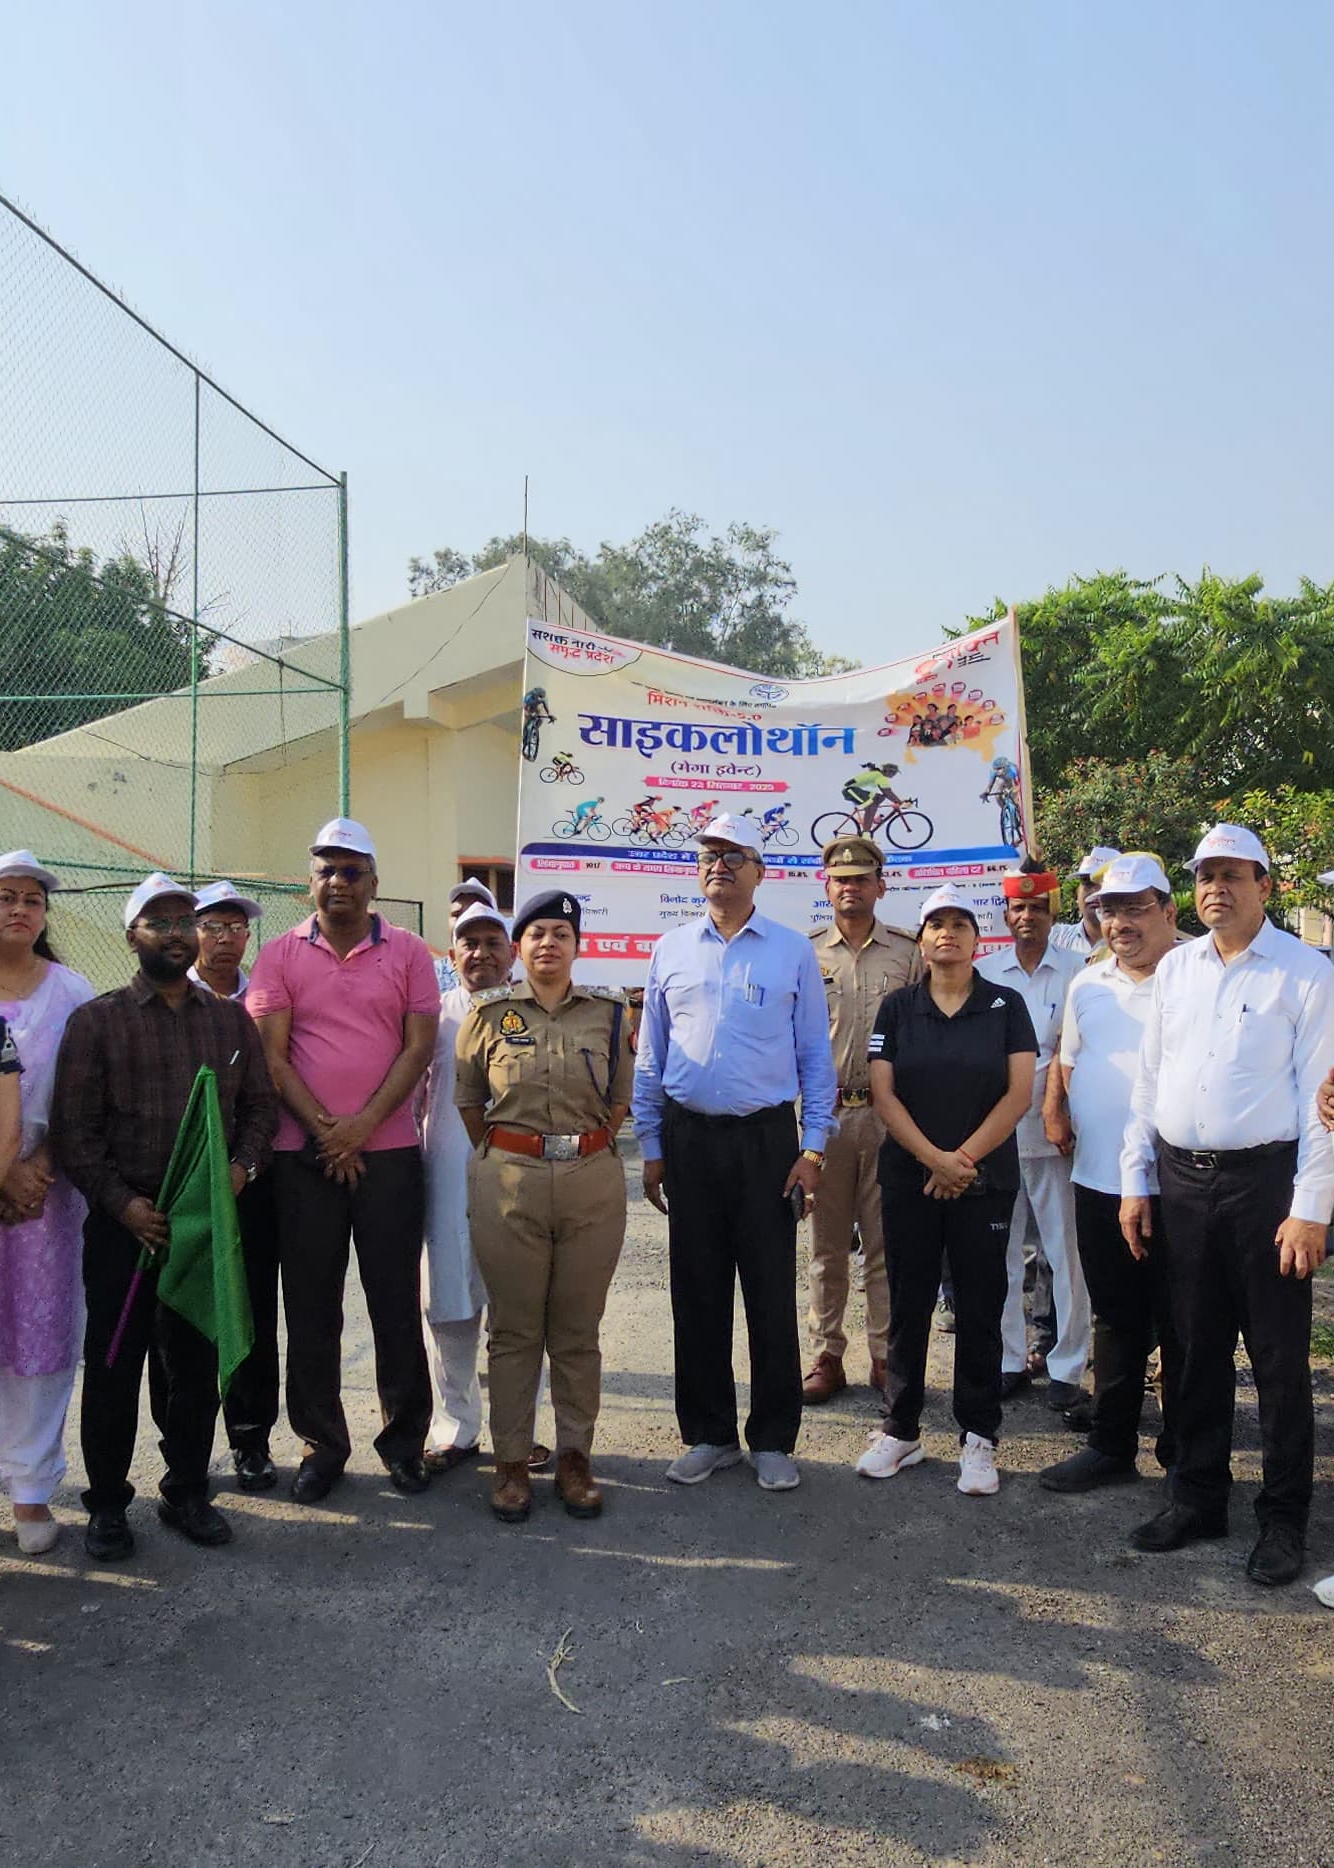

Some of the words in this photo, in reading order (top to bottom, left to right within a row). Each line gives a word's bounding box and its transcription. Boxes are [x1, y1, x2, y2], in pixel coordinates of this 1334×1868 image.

[577, 712, 858, 760] साइकलोथॉन
[670, 760, 710, 775] (मेगा
[595, 935, 630, 953] एवं
